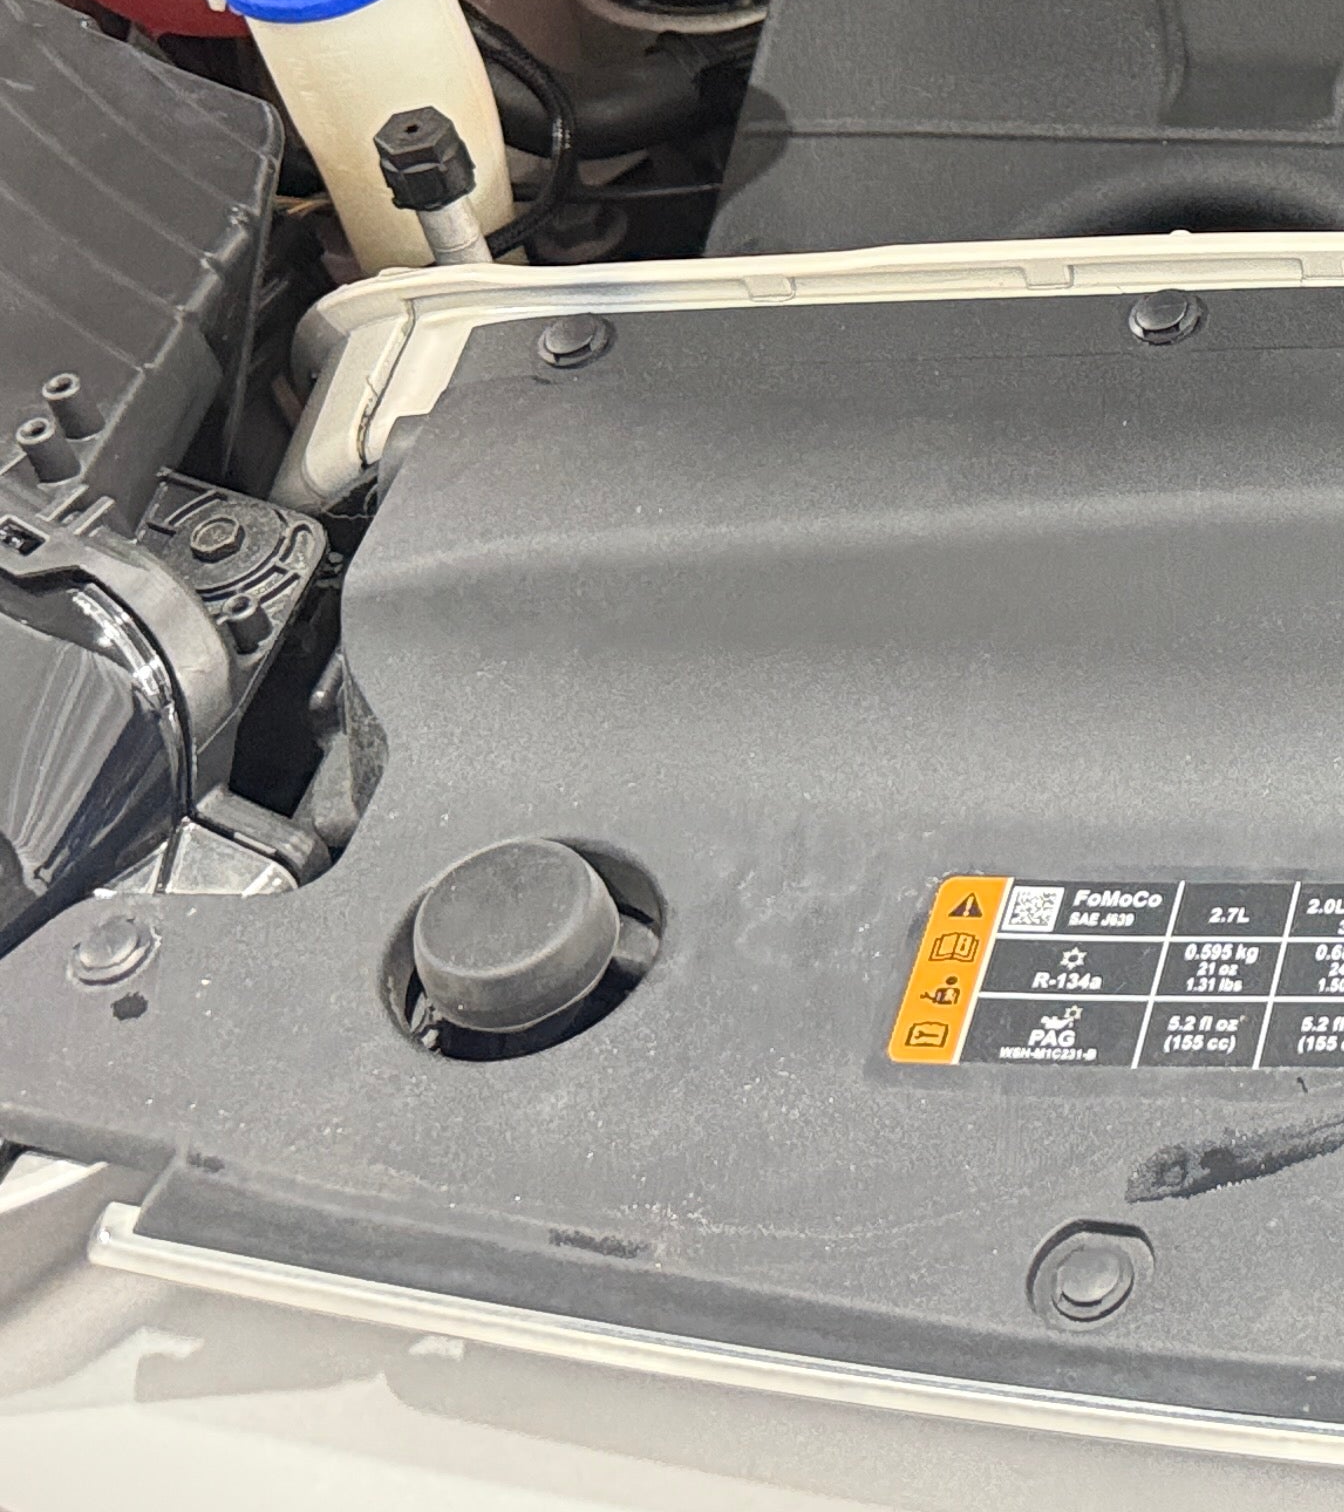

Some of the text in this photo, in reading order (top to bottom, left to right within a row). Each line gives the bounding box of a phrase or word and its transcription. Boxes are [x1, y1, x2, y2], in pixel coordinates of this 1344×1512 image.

[1072, 889, 1163, 908] FoMoCo
[1069, 912, 1100, 927] SAE
[1208, 907, 1250, 924] 2.7L
[1184, 943, 1260, 964] 0.595 kg
[1196, 962, 1239, 977] 21 oz
[1032, 972, 1103, 990] R-134a
[1186, 978, 1243, 993] 1.31 lbs
[1167, 1015, 1239, 1032] 5.2 fl oz
[1301, 1016, 1329, 1033] 5.2
[1028, 1029, 1076, 1047] PAG
[1163, 1035, 1236, 1055] (155 cc)
[1297, 1036, 1338, 1054] (155
